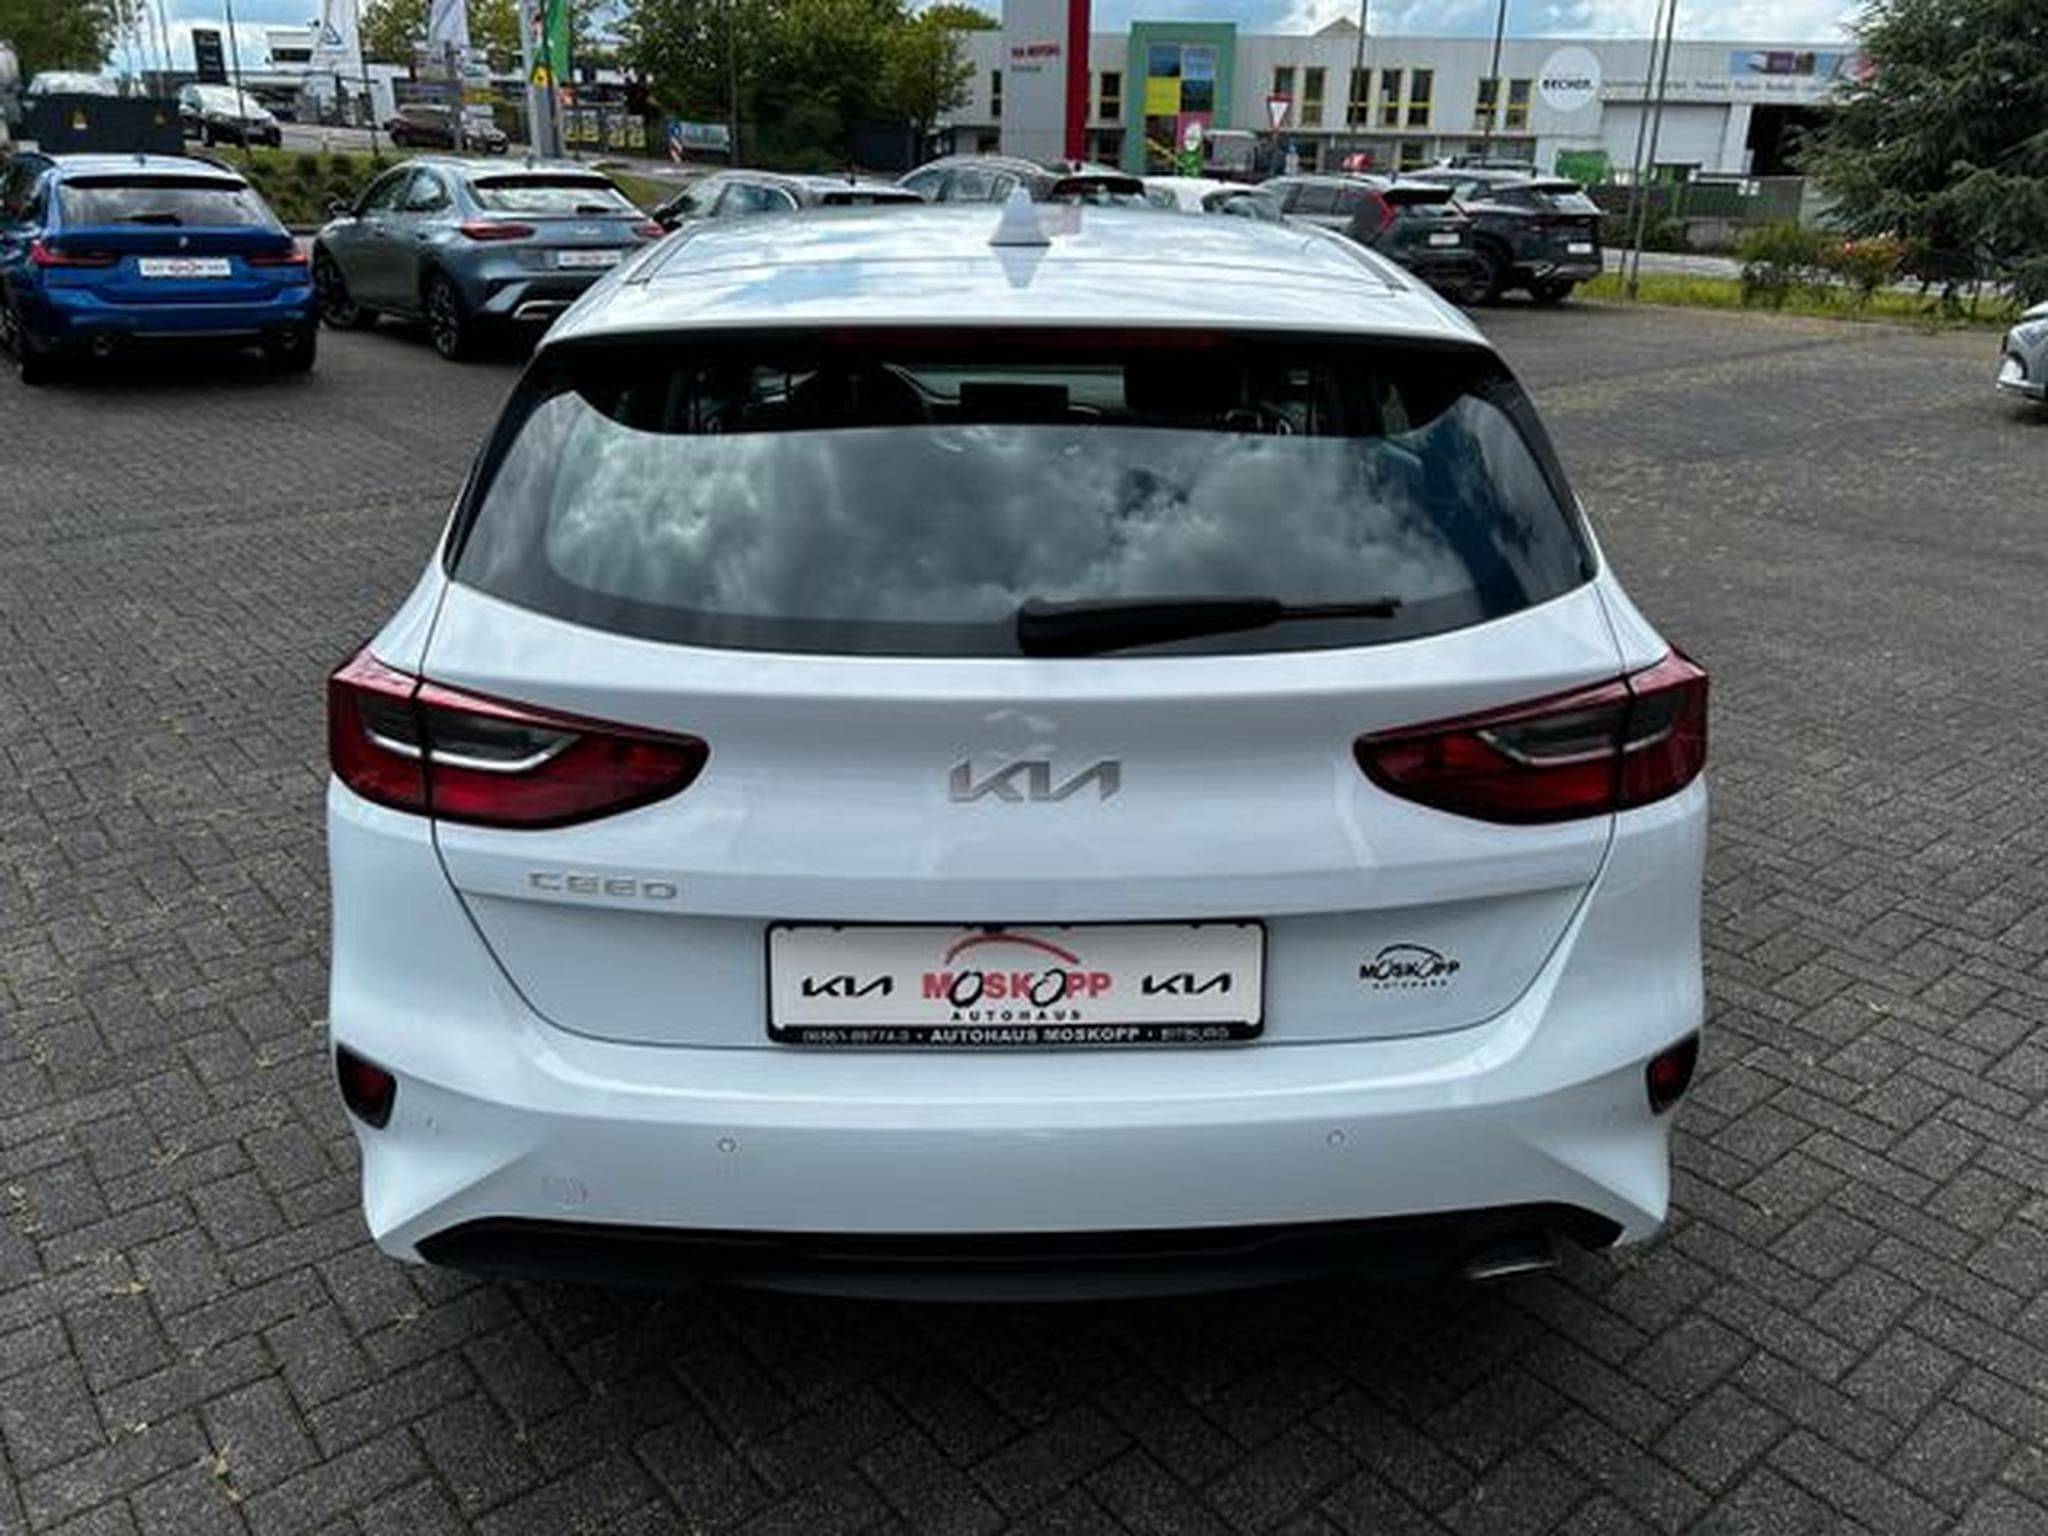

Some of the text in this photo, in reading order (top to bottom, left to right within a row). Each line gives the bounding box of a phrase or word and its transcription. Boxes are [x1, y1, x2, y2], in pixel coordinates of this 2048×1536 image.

[949, 760, 1122, 802] KIA
[1359, 957, 1460, 980] MOSKOPP
[801, 974, 894, 997] KIA
[922, 968, 1112, 1008] MOSKOPP
[1141, 972, 1232, 995] KIA
[951, 1010, 1081, 1021] AUTOHAUS
[929, 1028, 1038, 1042] AUTOHAUS
[1043, 1026, 1140, 1041] MOSKOPP
